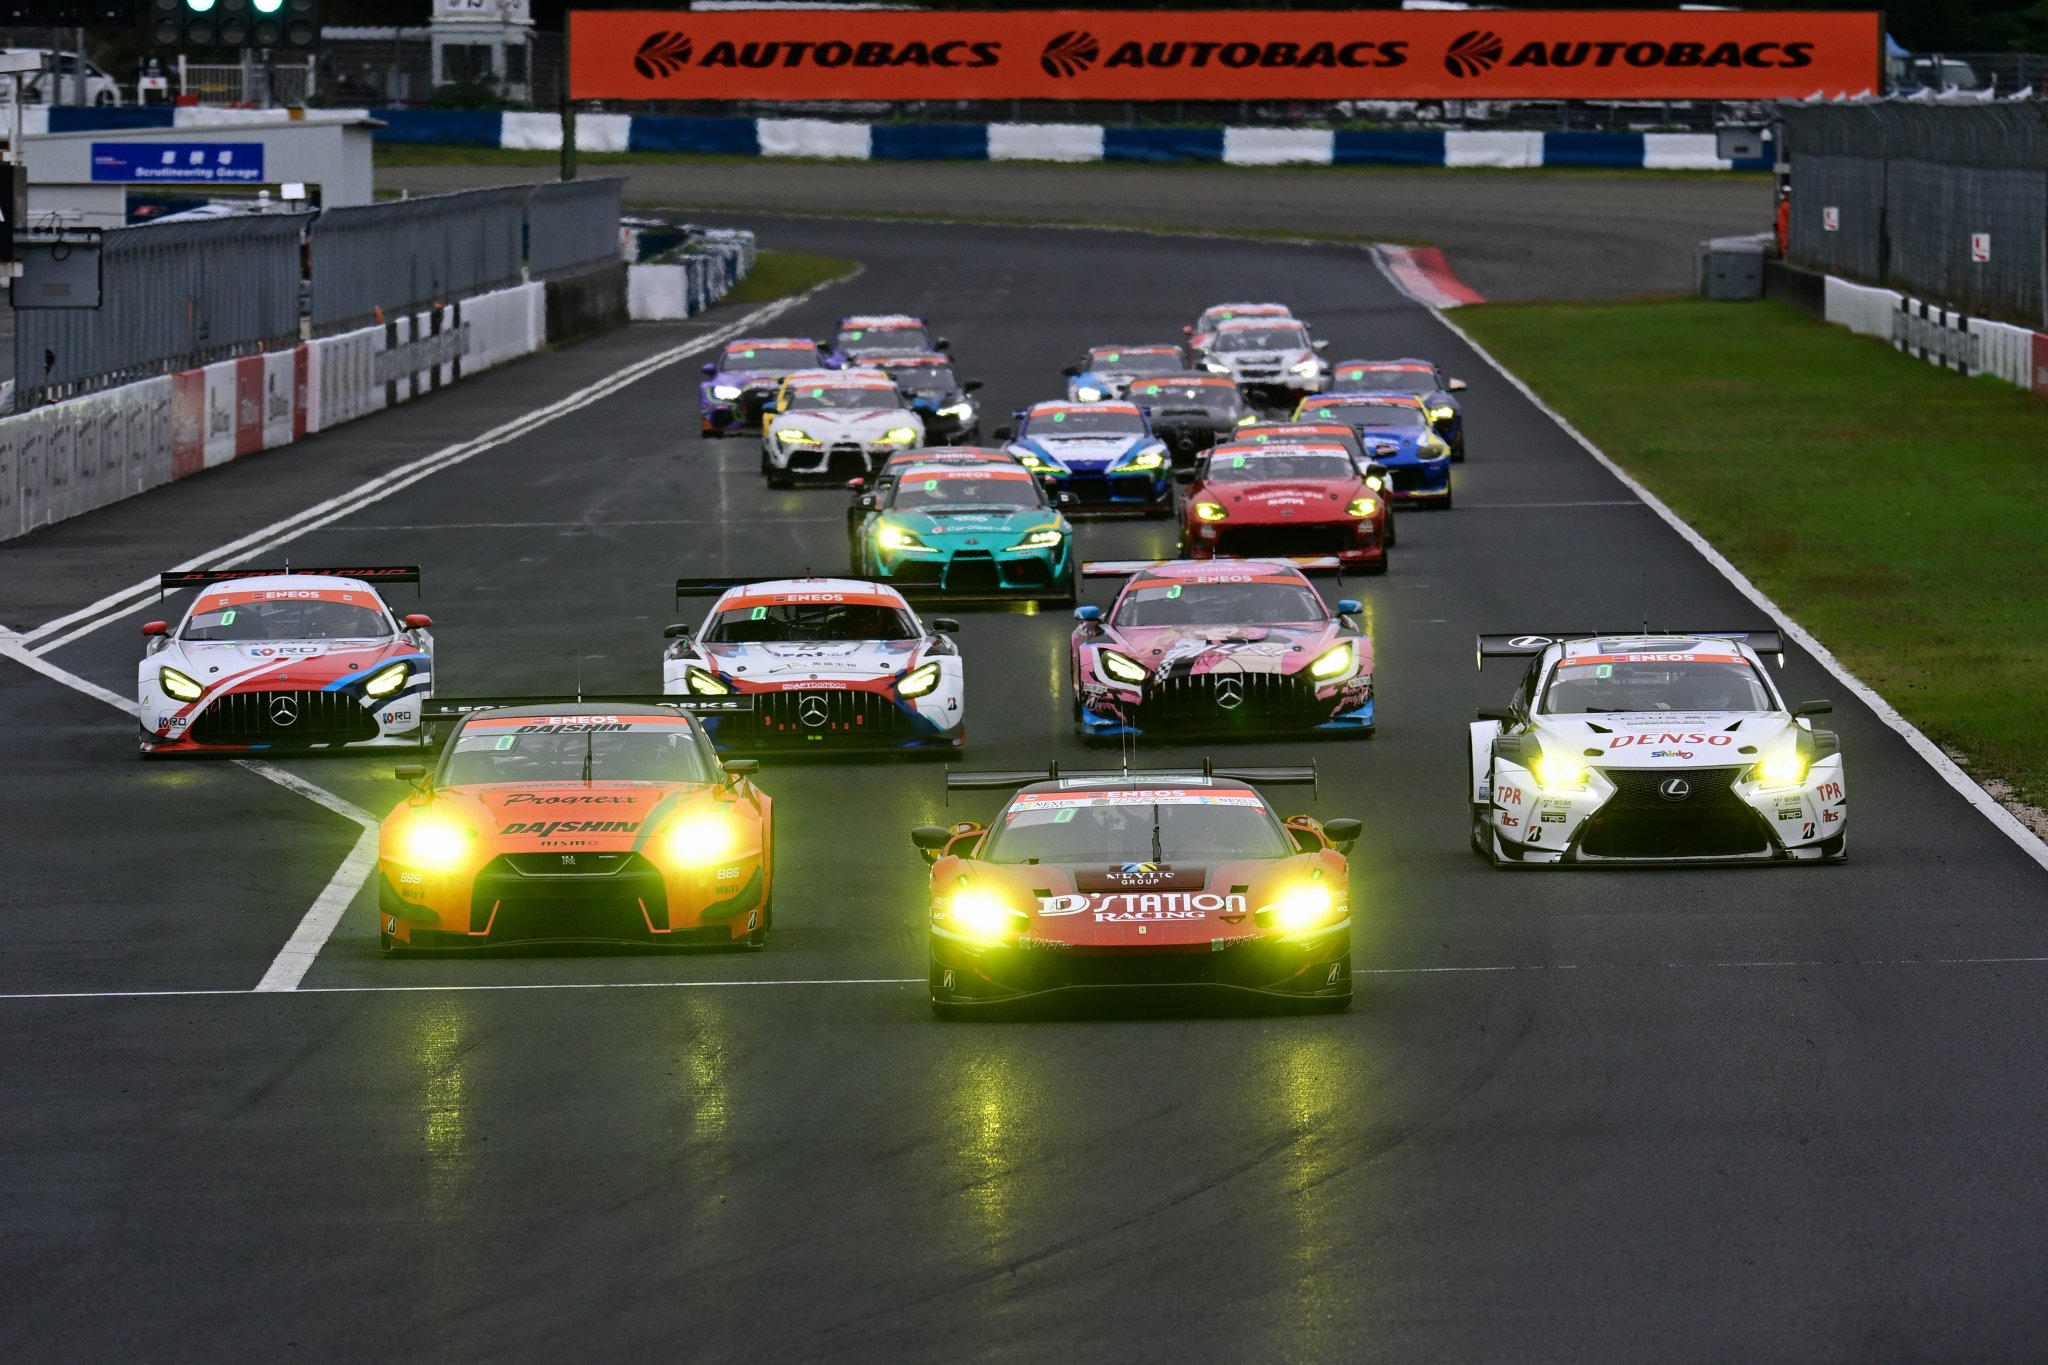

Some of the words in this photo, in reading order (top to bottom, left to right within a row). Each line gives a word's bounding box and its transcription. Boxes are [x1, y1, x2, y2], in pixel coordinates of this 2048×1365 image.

[697, 41, 1001, 68] AUTOBACS
[1104, 41, 1409, 68] AUTOBACS
[1508, 41, 1815, 69] AUTOBACS
[135, 167, 214, 179] Scrutineering
[216, 167, 259, 179] Garage
[1197, 575, 1253, 583] ENEOS
[266, 591, 320, 599] ENEOS
[787, 594, 844, 602] ENEOS
[1629, 654, 1695, 662] ENEOS
[549, 715, 619, 724] ENEOS
[514, 723, 633, 735] DAISHIN
[1609, 733, 1733, 749] DENSO
[1106, 790, 1187, 798] ENEOS
[1497, 785, 1522, 805] TPR
[1816, 782, 1842, 801] TPR
[503, 793, 638, 806] Progrexx
[500, 821, 641, 838] DAISHIN
[401, 872, 423, 884] BBS
[717, 867, 740, 880] BBS
[1121, 878, 1160, 886] GROUP
[1093, 911, 1206, 922] RACING
